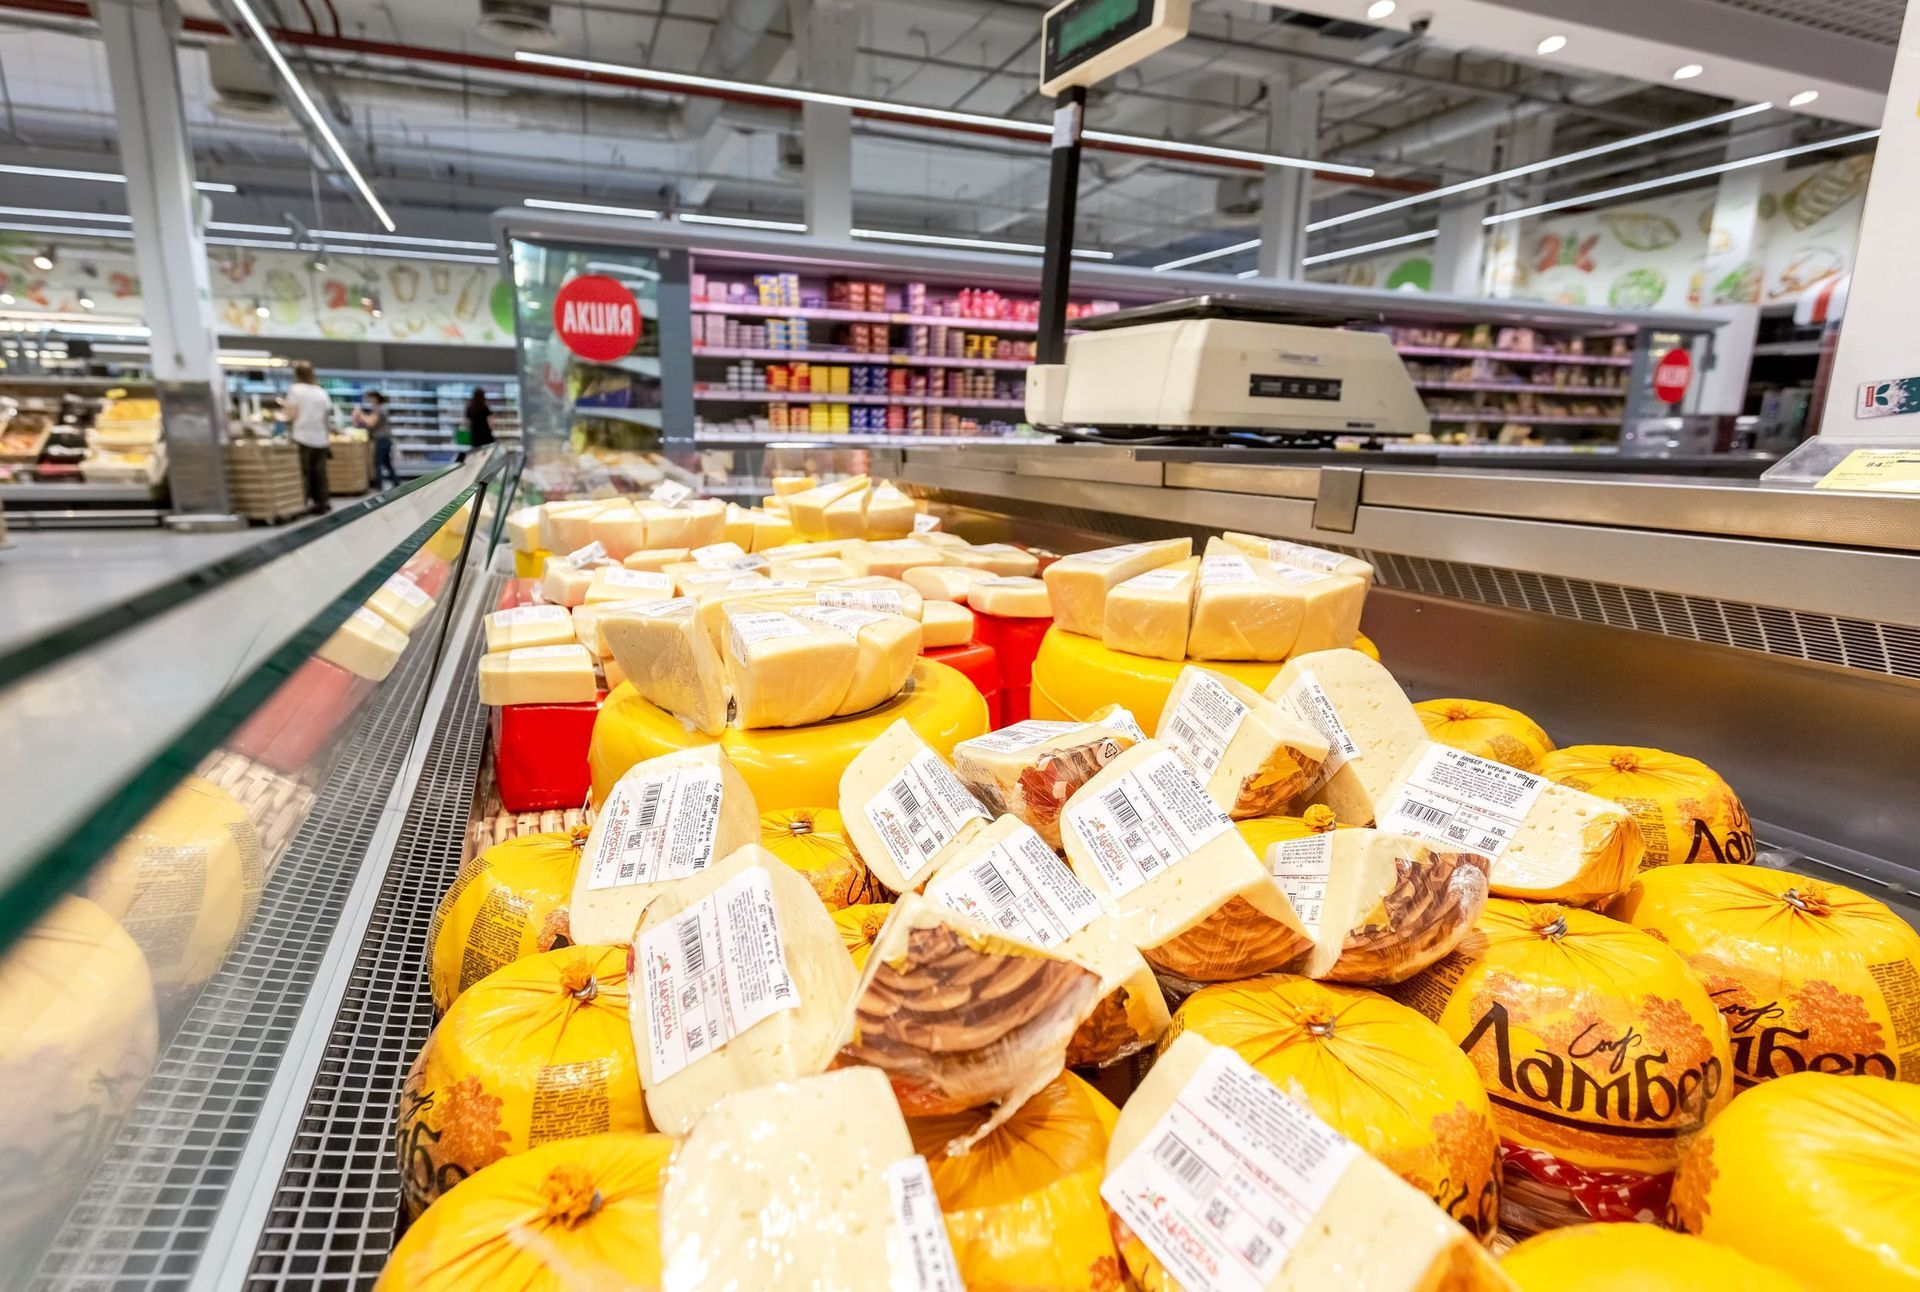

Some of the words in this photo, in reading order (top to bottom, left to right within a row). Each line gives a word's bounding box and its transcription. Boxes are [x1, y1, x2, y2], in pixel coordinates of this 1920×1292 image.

[562, 300, 634, 336] АКЦИЯ
[605, 819, 624, 863] КАРУСЕЛЬ
[887, 821, 911, 856] КАРУСЕЛЬ
[1096, 832, 1126, 872] КАРУСЕЛЬ
[657, 977, 674, 1041] КАРУСЕЛЬ
[1459, 1000, 1722, 1124] Ламбер
